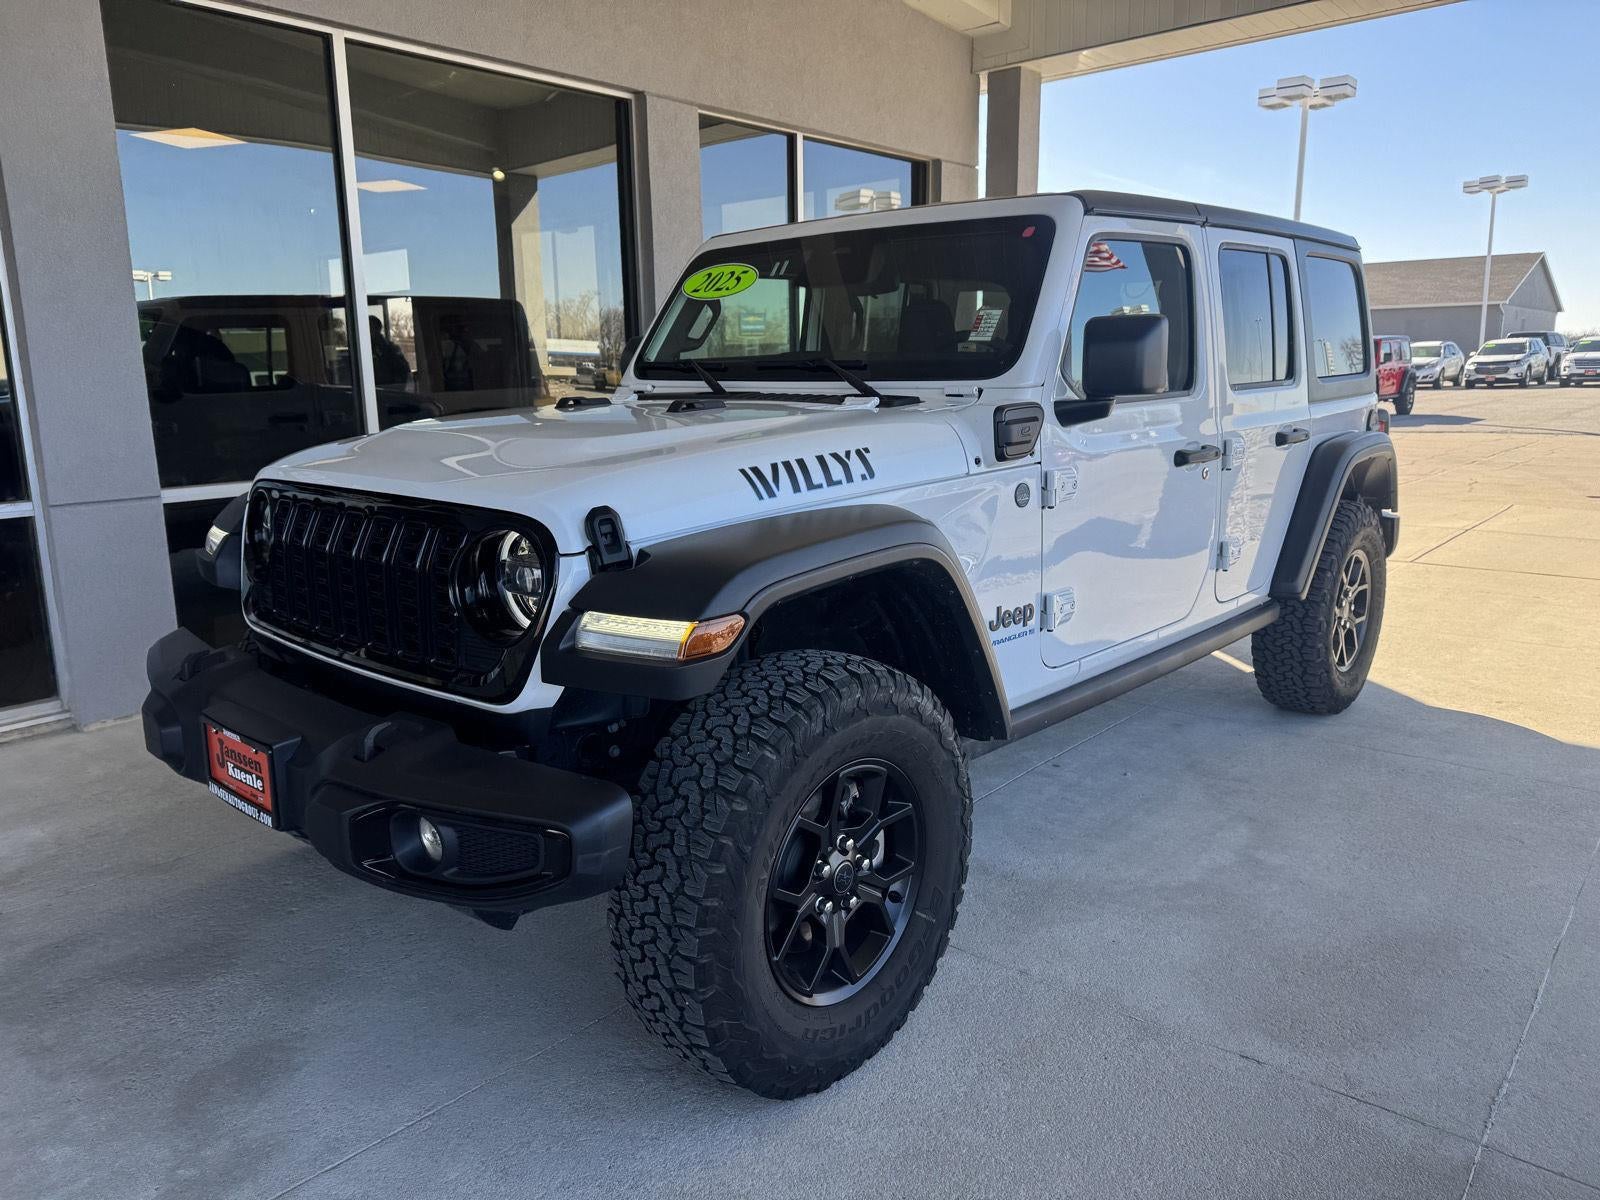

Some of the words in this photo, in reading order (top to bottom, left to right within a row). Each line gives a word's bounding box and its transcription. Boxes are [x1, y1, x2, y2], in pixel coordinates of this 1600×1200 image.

[690, 270, 750, 293] 2025
[738, 447, 875, 500] WILLYS
[989, 603, 1035, 632] Jeep
[216, 738, 263, 774] Janssen
[226, 761, 264, 791] Kuenle
